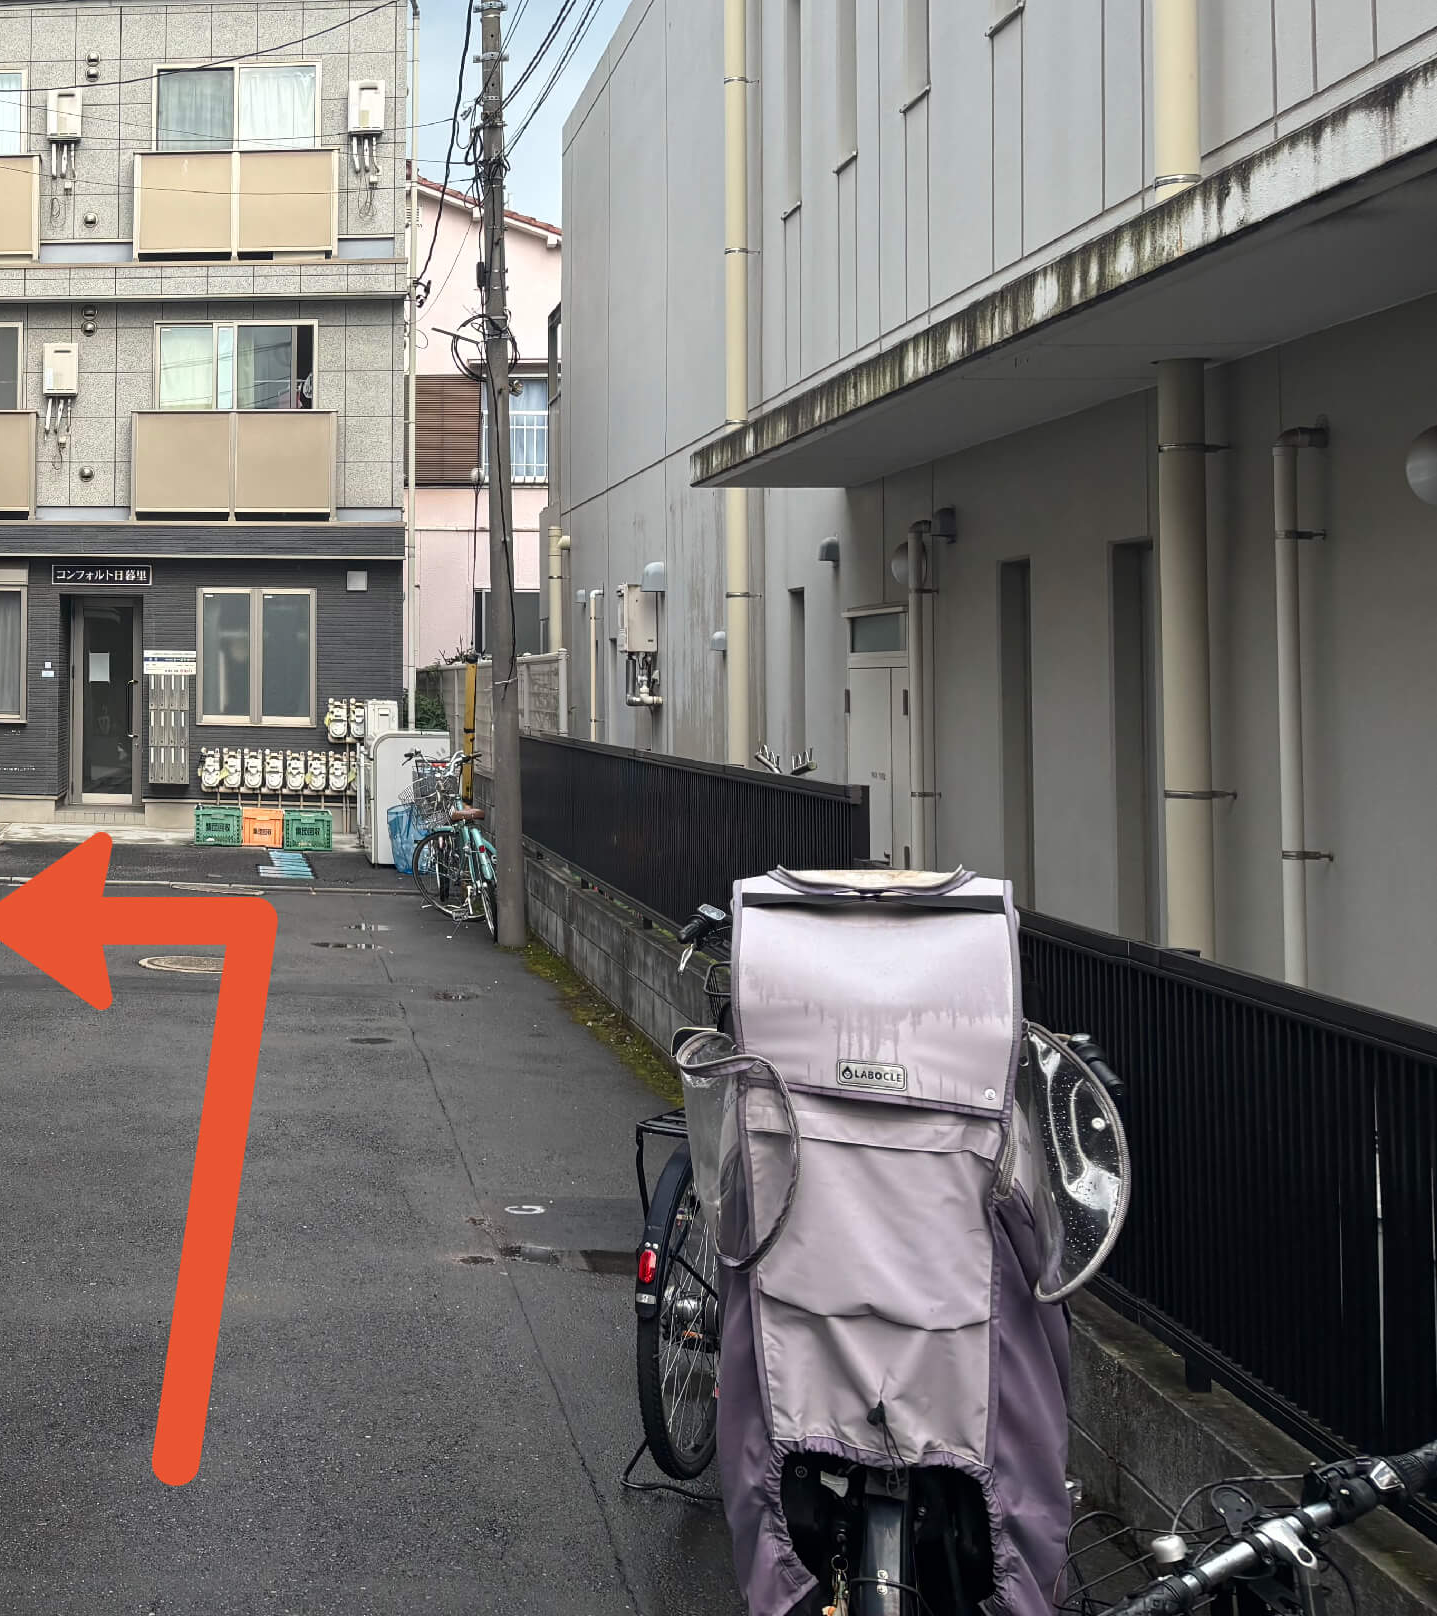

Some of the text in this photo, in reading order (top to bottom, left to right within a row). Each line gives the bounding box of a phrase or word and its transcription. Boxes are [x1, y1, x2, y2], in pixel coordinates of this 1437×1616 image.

[56, 569, 147, 580] コンフォルト日暮里
[854, 1070, 902, 1082] LABOCLE
